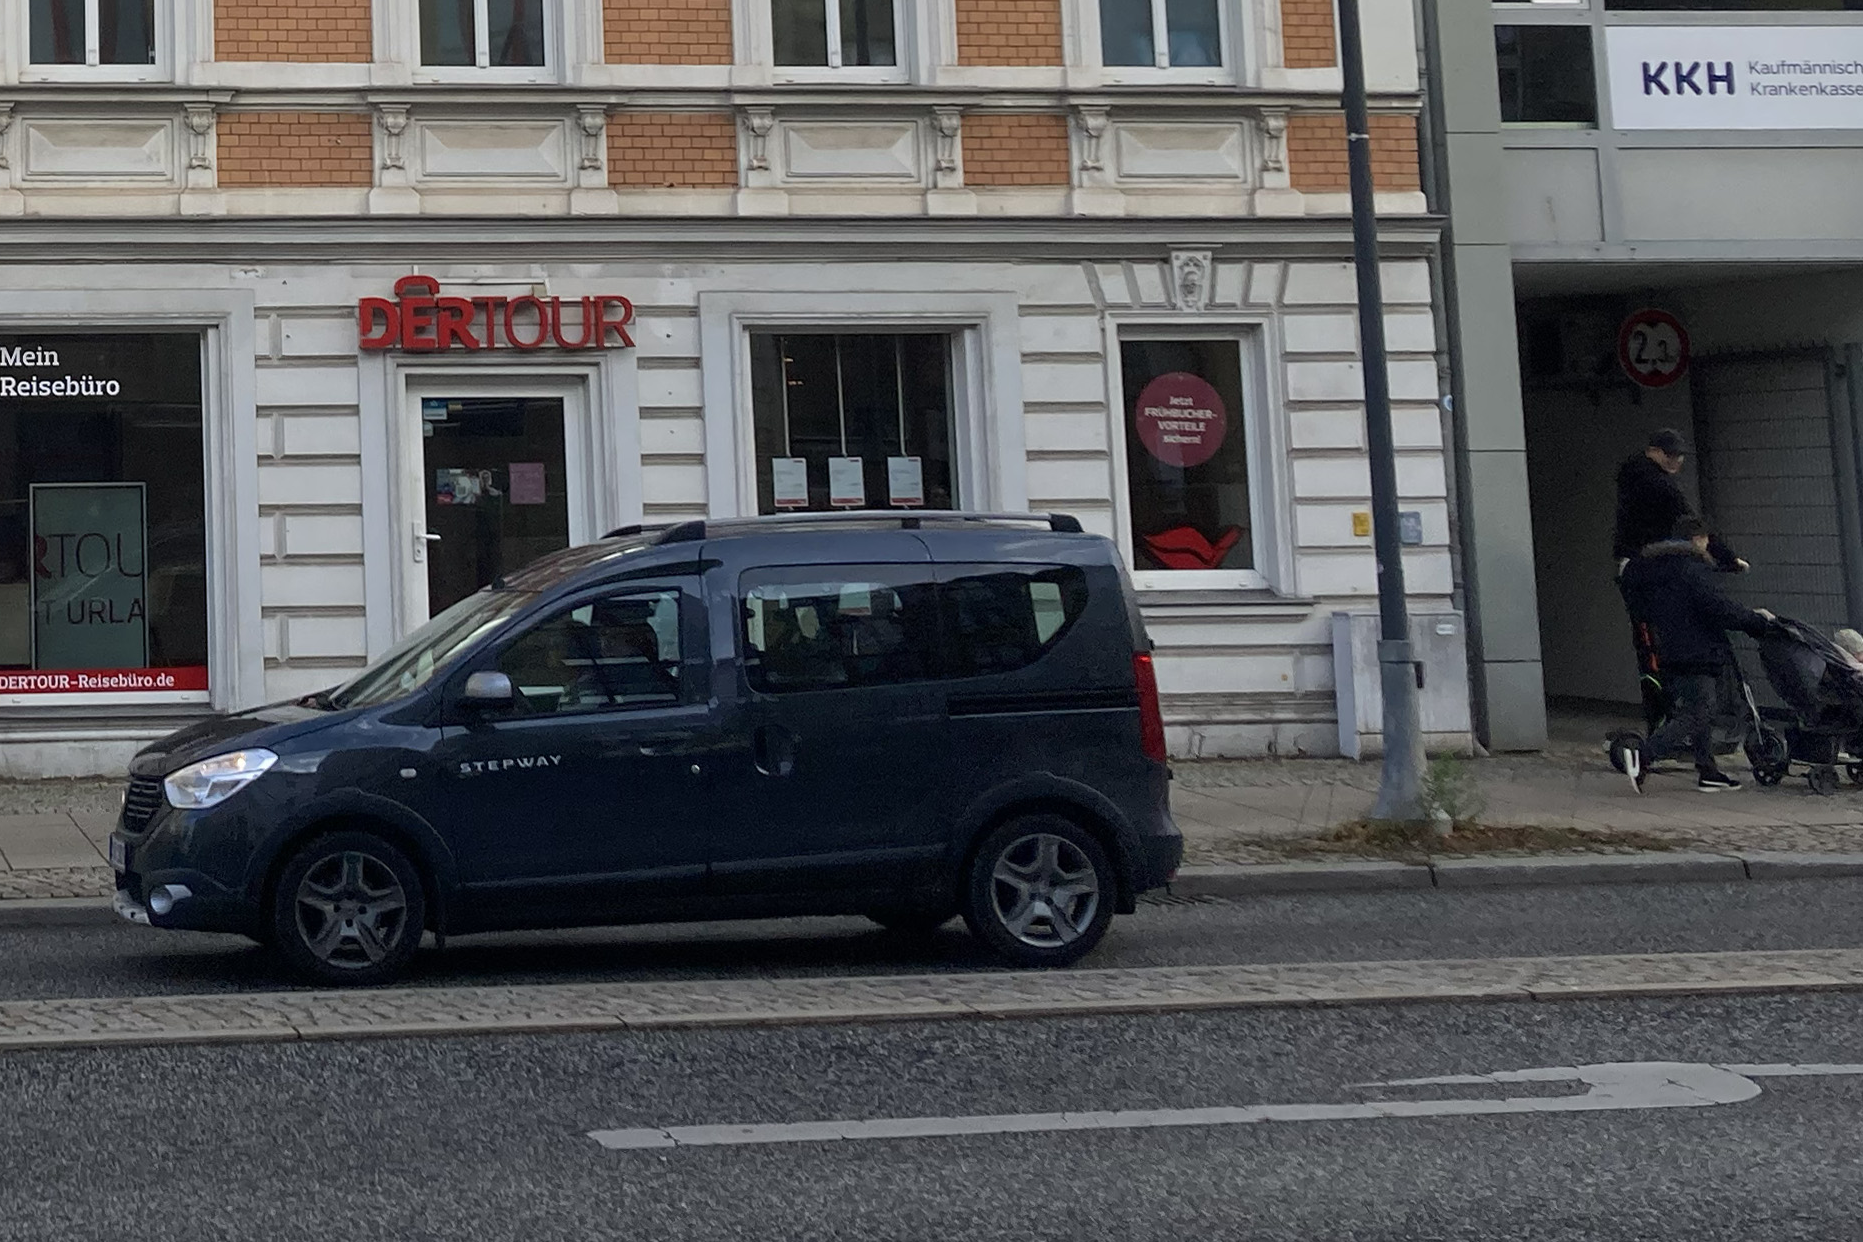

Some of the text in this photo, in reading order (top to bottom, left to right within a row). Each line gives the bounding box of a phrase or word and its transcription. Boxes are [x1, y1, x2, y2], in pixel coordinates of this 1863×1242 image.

[1642, 61, 1736, 96] KKH
[1750, 81, 1863, 96] Krankenkasse
[358, 292, 636, 350] DERTOUR
[0, 346, 60, 367] Mein
[0, 375, 121, 397] Reisebüro
[1157, 420, 1206, 432] VORTEILE
[460, 755, 561, 772] STEPWAY
